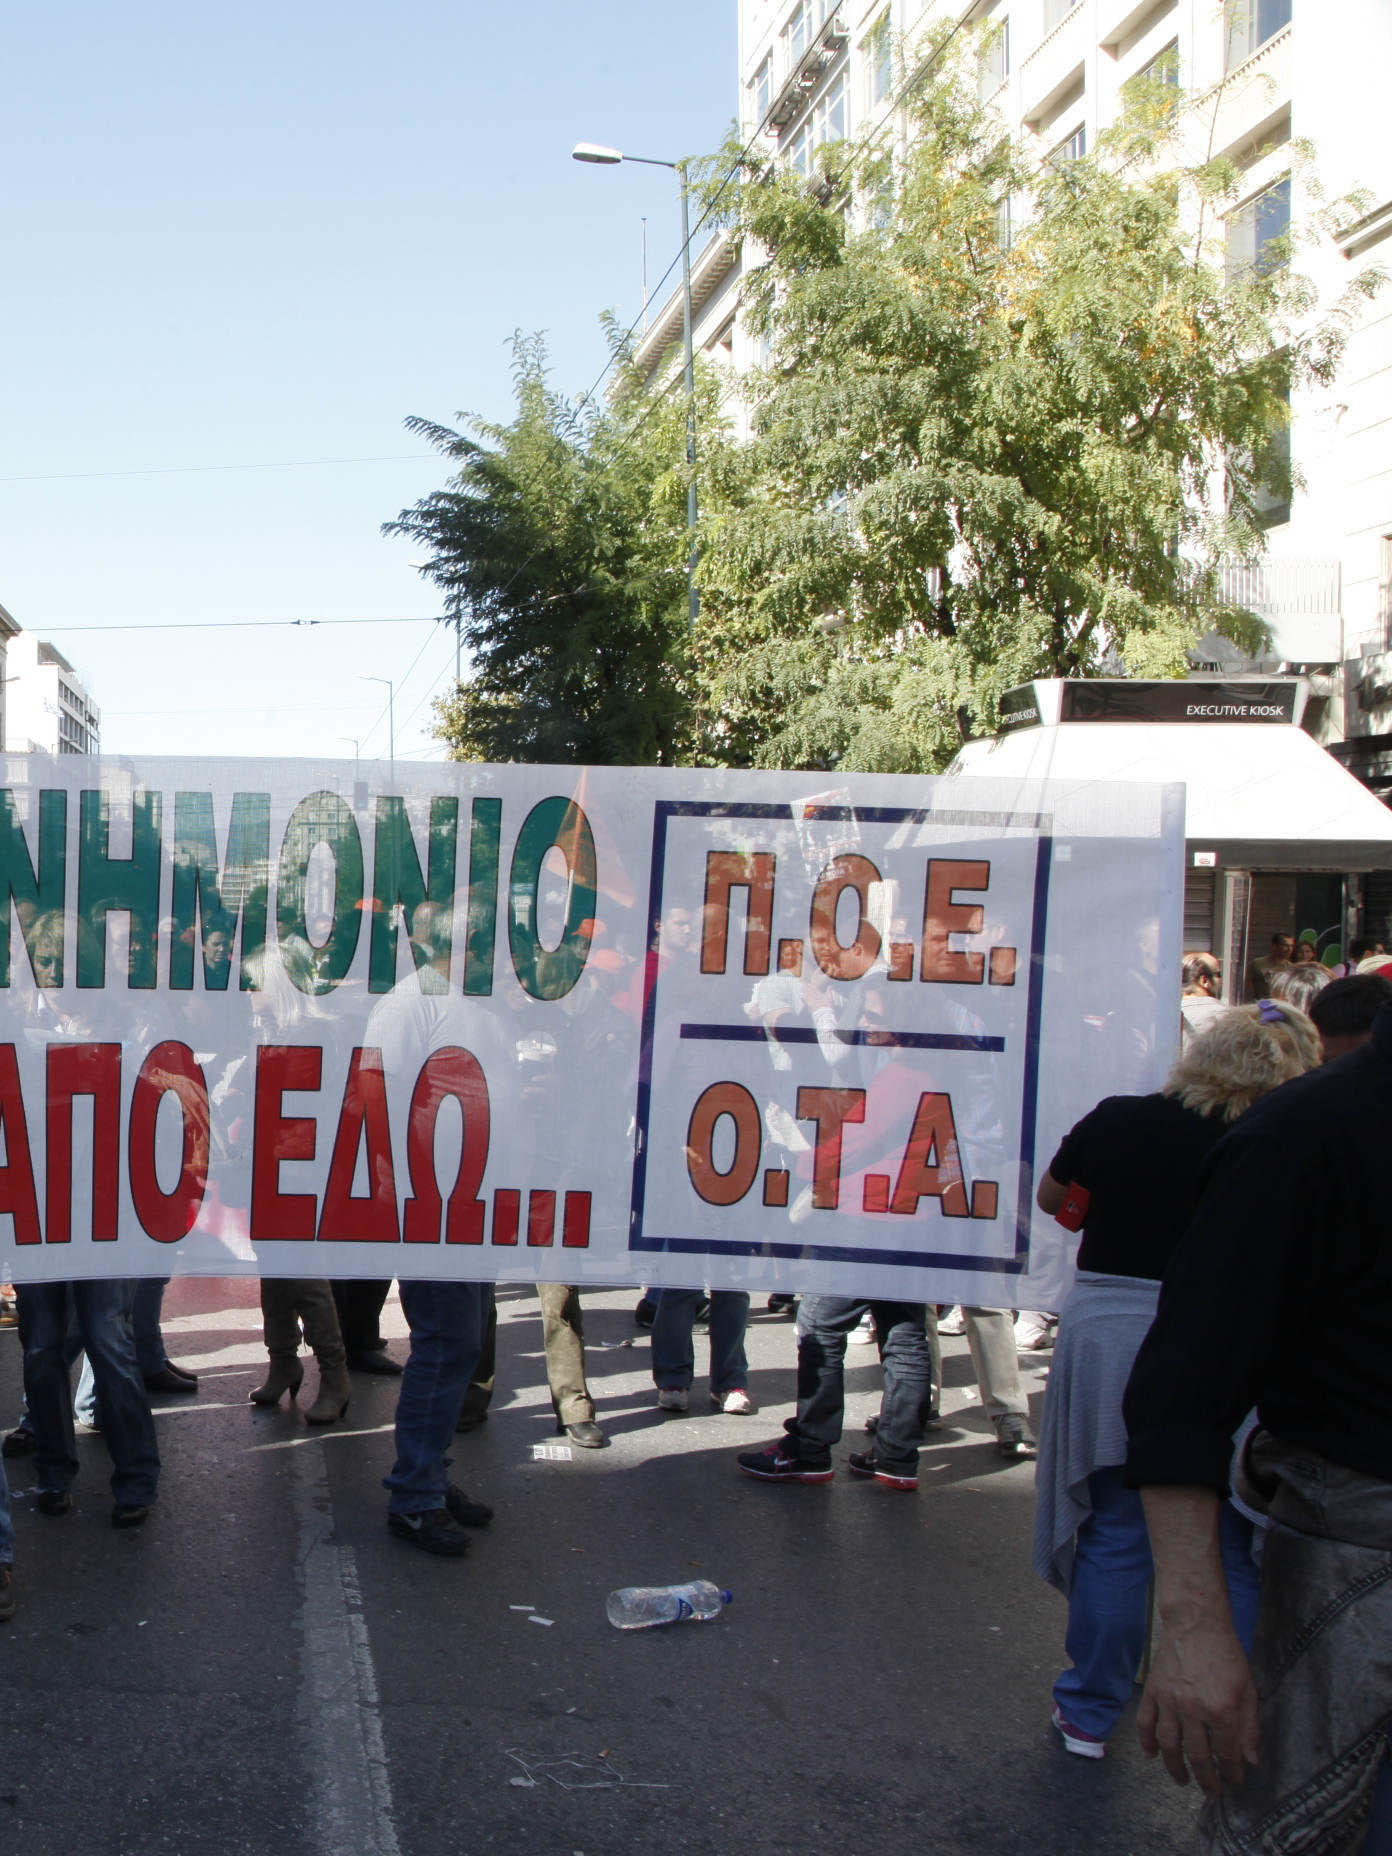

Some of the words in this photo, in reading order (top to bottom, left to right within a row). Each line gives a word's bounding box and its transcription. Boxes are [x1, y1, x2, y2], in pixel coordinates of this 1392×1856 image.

[1187, 705, 1248, 716] EXECUTIVE
[1249, 705, 1284, 716] KIOSK
[699, 851, 1017, 986] Π.Ο.Ε.
[250, 1045, 592, 1247] ΕΔΩ...
[687, 1081, 999, 1220] Ο.Τ.Α.
